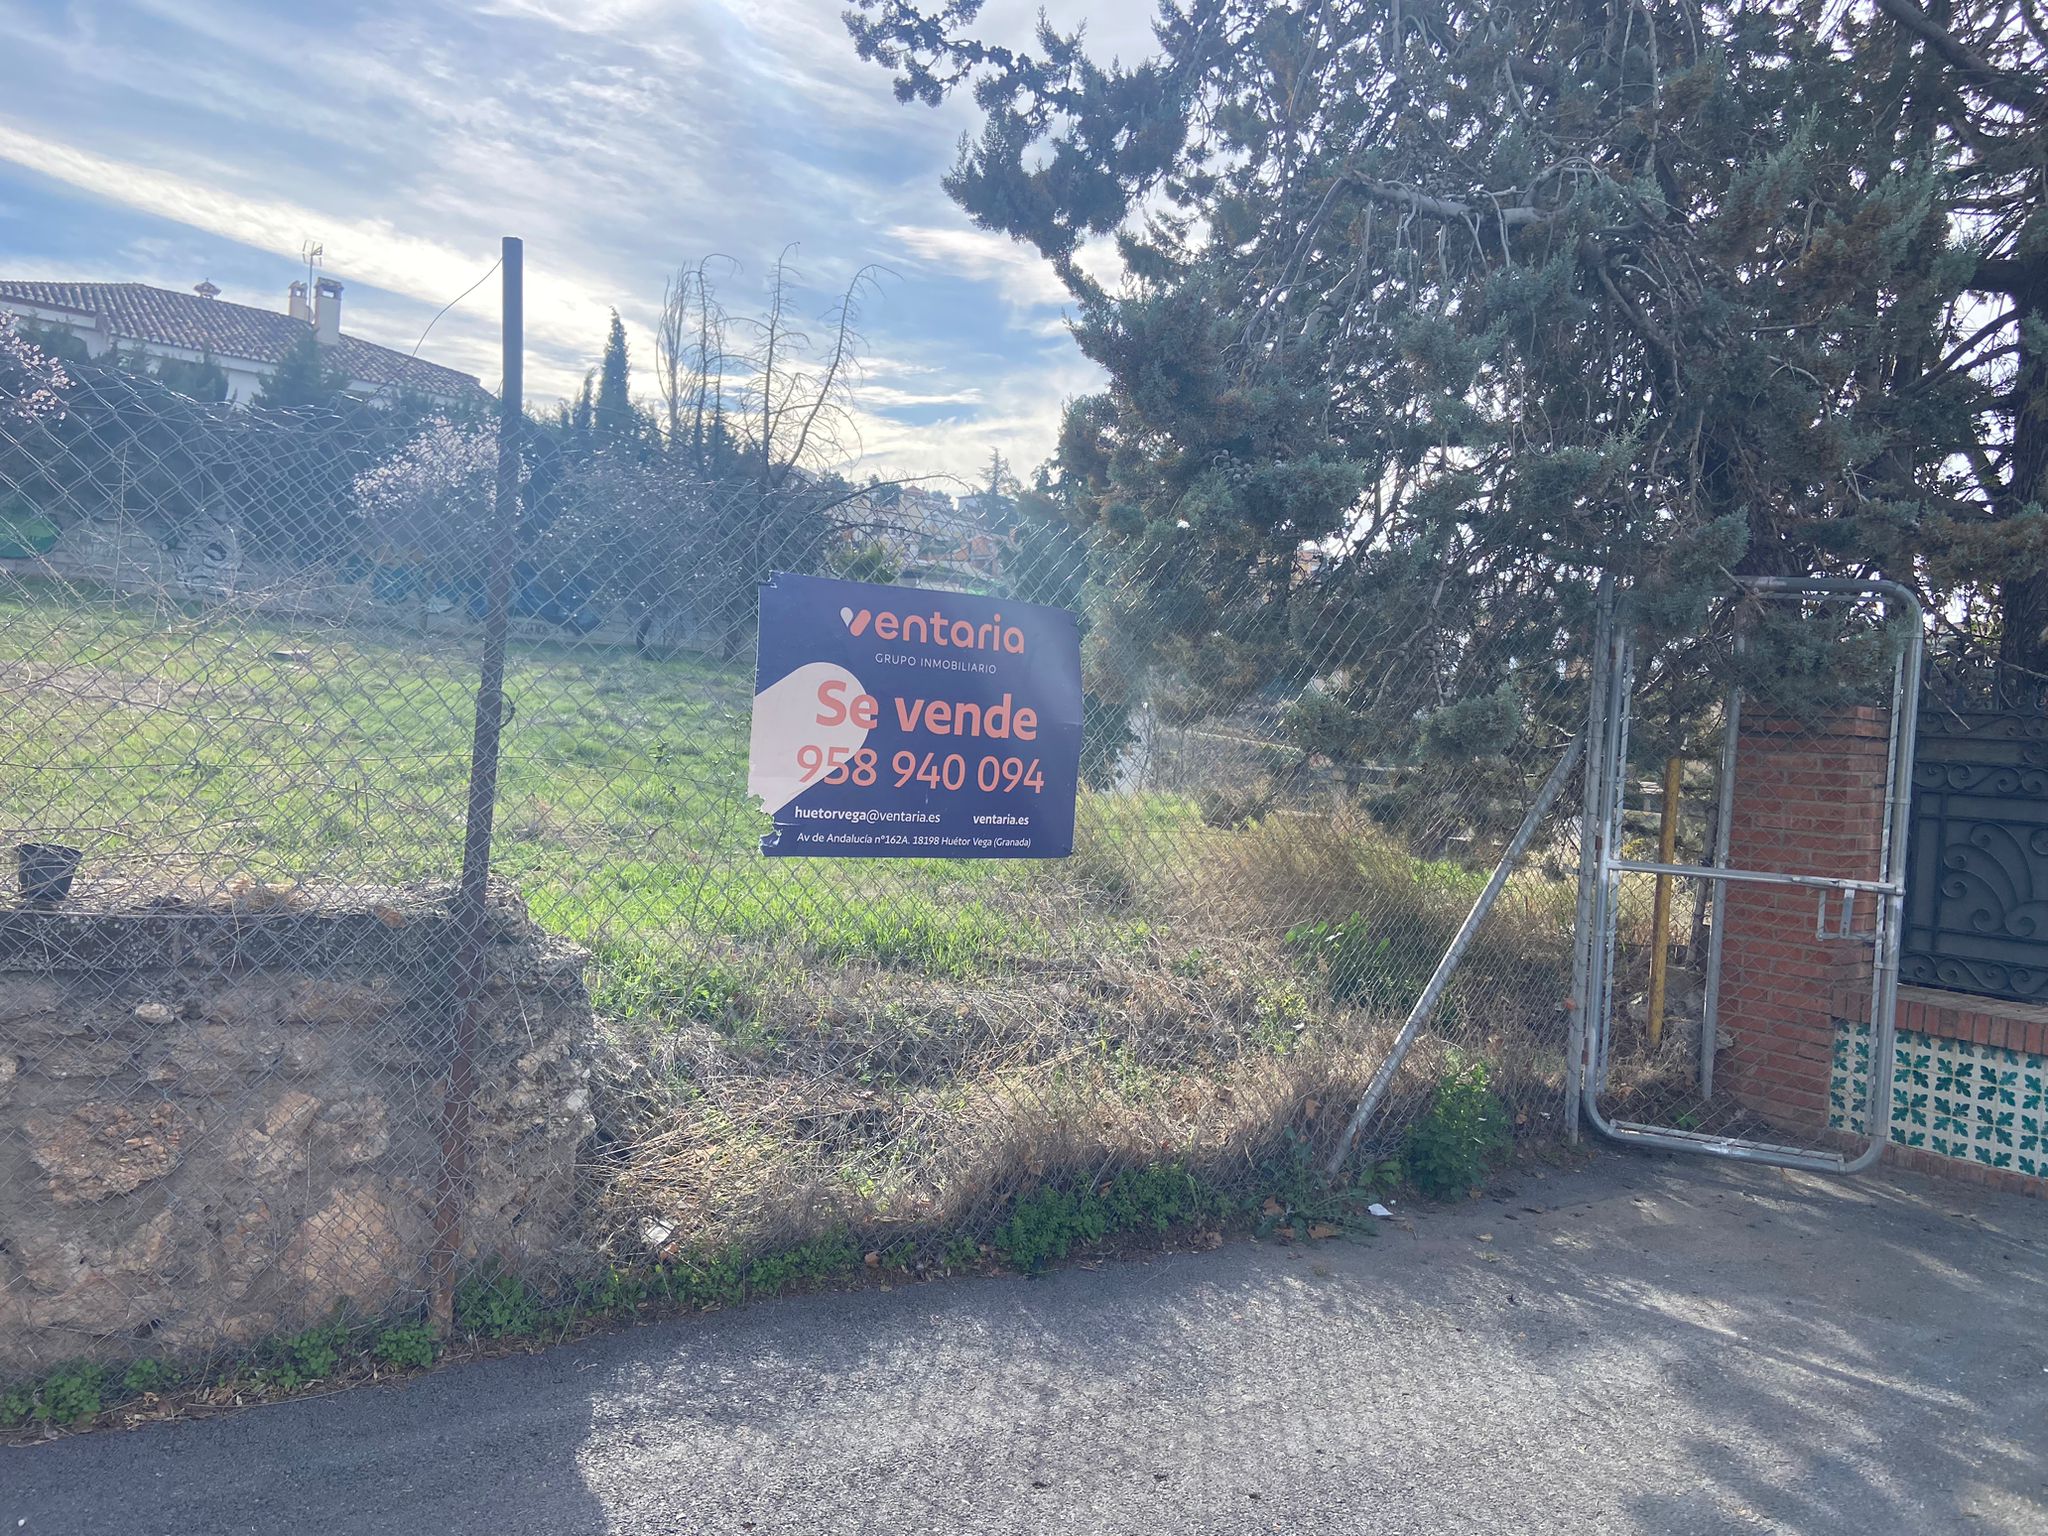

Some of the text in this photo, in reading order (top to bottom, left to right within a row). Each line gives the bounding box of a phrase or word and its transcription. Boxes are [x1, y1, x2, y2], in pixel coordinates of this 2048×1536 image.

[840, 607, 1025, 654] ventaria
[874, 653, 997, 674] GRUPO INMOBILIARIO
[816, 680, 1038, 741] Se vende
[796, 744, 1044, 794] 958 940 094
[795, 806, 941, 824] huetorvega@ventaria.es
[972, 813, 1030, 825] ventaria.es
[797, 832, 810, 842] Av
[812, 833, 825, 843] de
[826, 833, 873, 844] Andalucía
[912, 836, 940, 846] 18198
[941, 836, 971, 846] Huétor
[972, 837, 992, 849] Vega
[993, 838, 1032, 849] (Granada)
